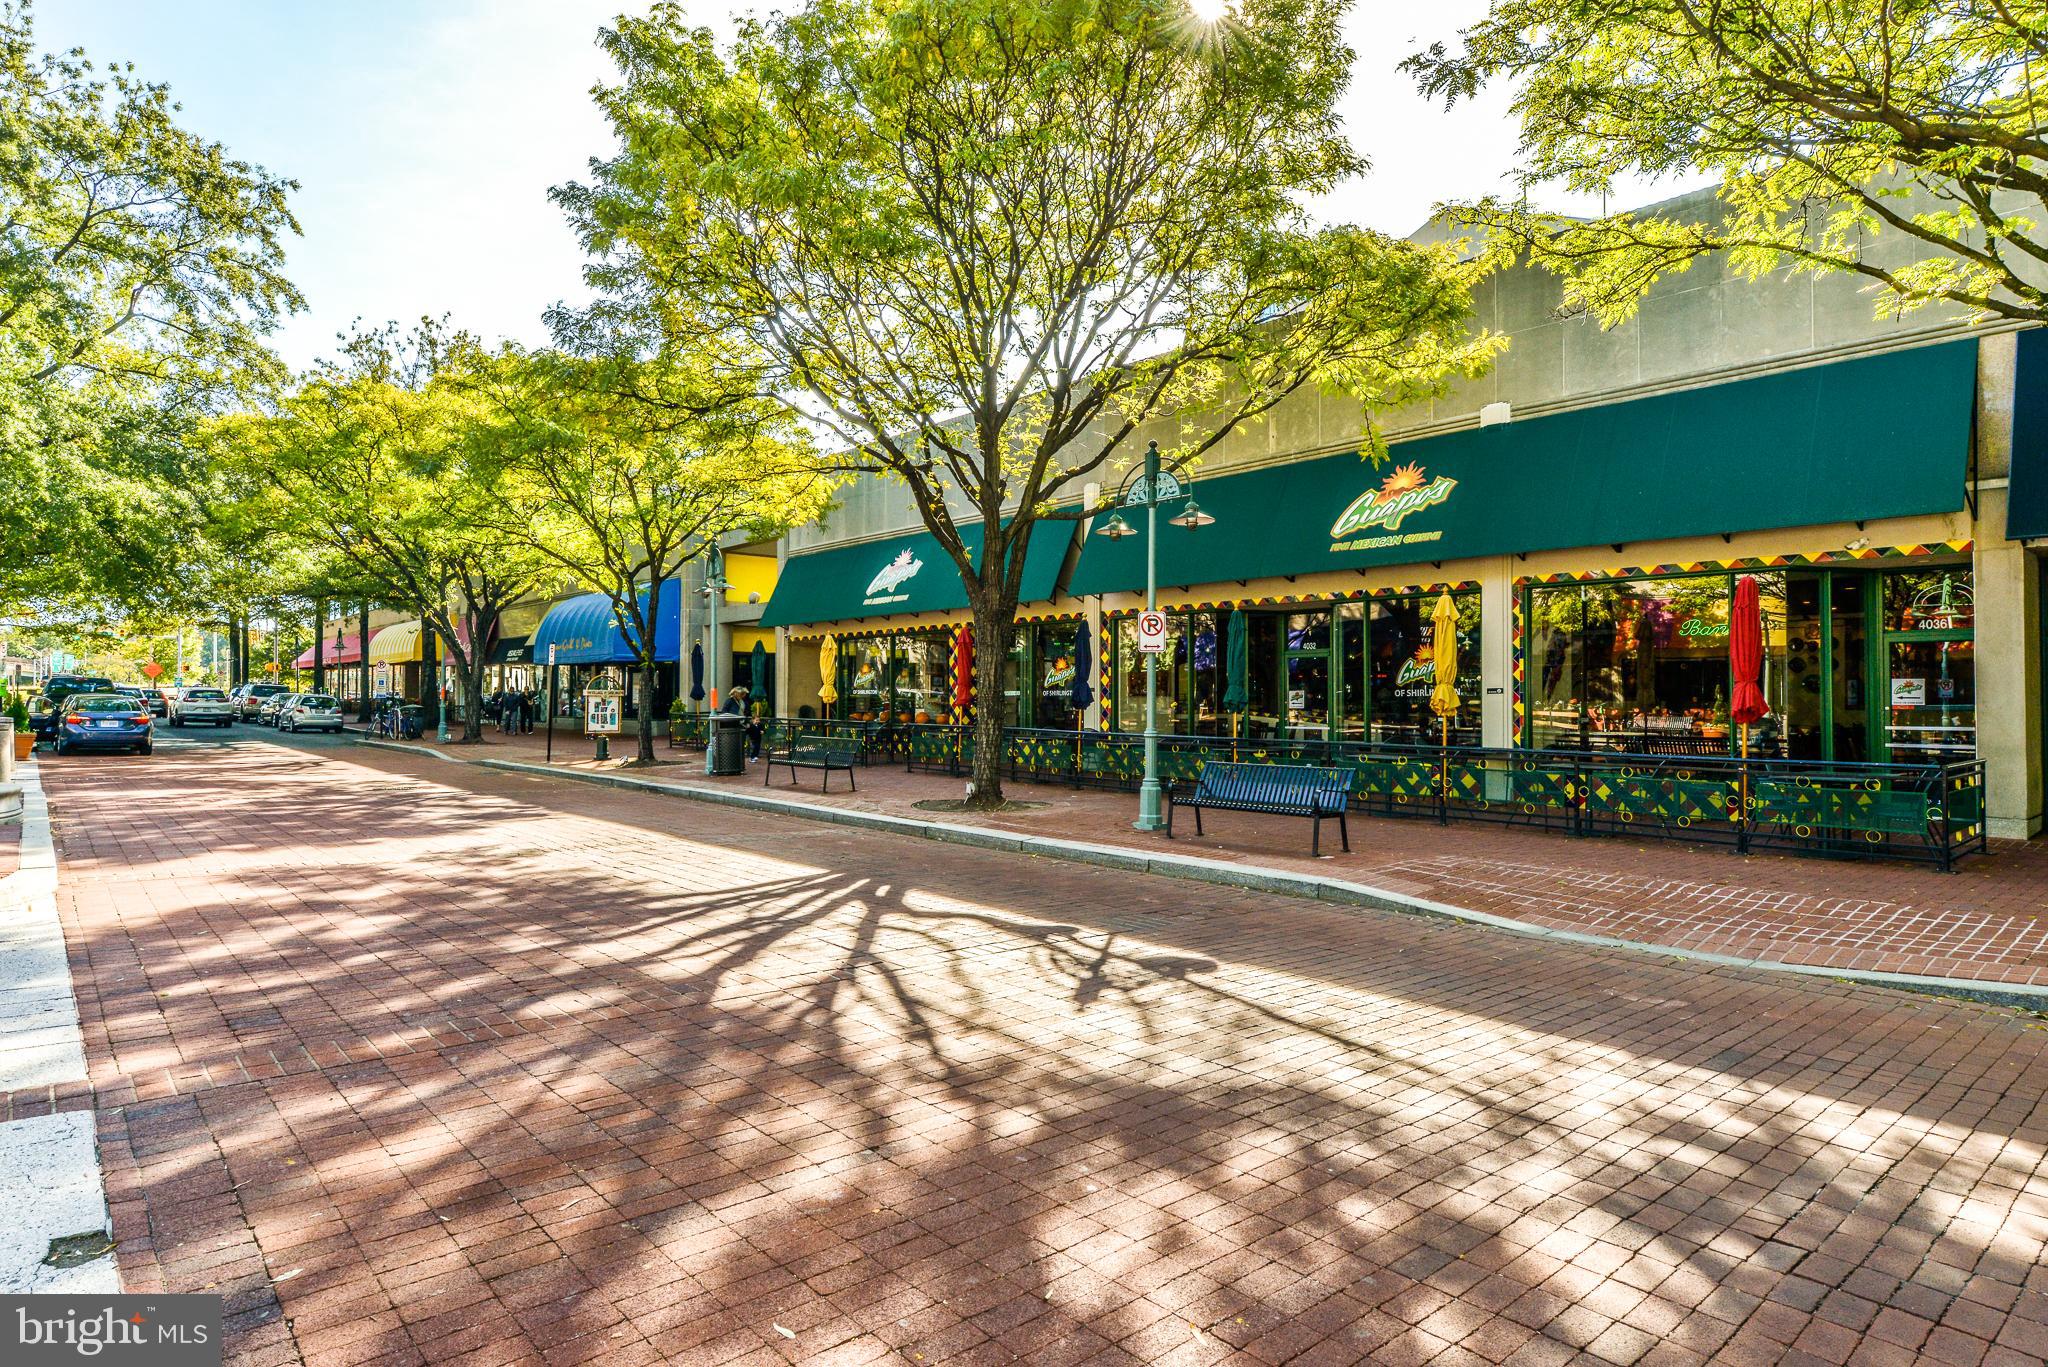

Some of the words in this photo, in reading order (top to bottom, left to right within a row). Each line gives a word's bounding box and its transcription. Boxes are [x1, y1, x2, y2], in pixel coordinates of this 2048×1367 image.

[1332, 477, 1455, 537] Guapo's
[1350, 535, 1403, 550] MEXICAN
[1918, 619, 1948, 629] 4036
[1302, 642, 1317, 650] 4032
[1397, 659, 1436, 686] Guap
[1394, 689, 1405, 697] OF
